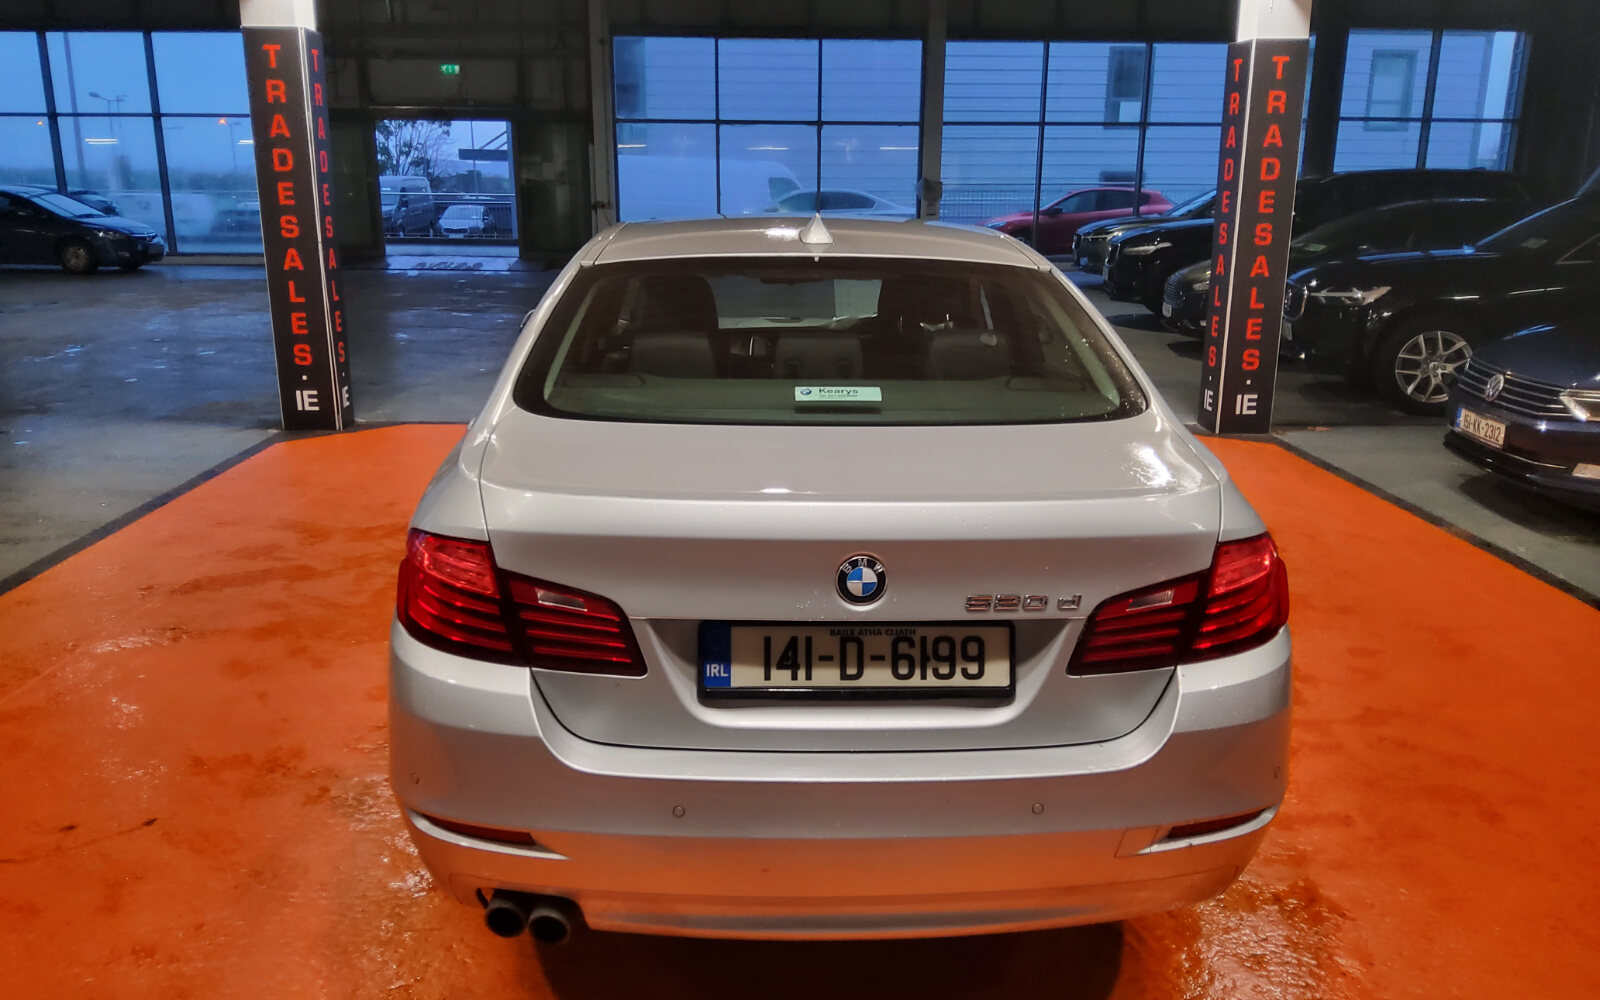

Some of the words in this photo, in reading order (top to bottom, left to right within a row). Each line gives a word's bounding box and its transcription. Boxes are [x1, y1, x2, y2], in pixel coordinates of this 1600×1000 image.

[842, 558, 884, 574] BMW
[965, 594, 1048, 611] 520
[830, 628, 856, 637] BAILE
[885, 628, 916, 637] CLIATH
[763, 635, 986, 682] 141-D-6199
[706, 664, 729, 677] IRL
